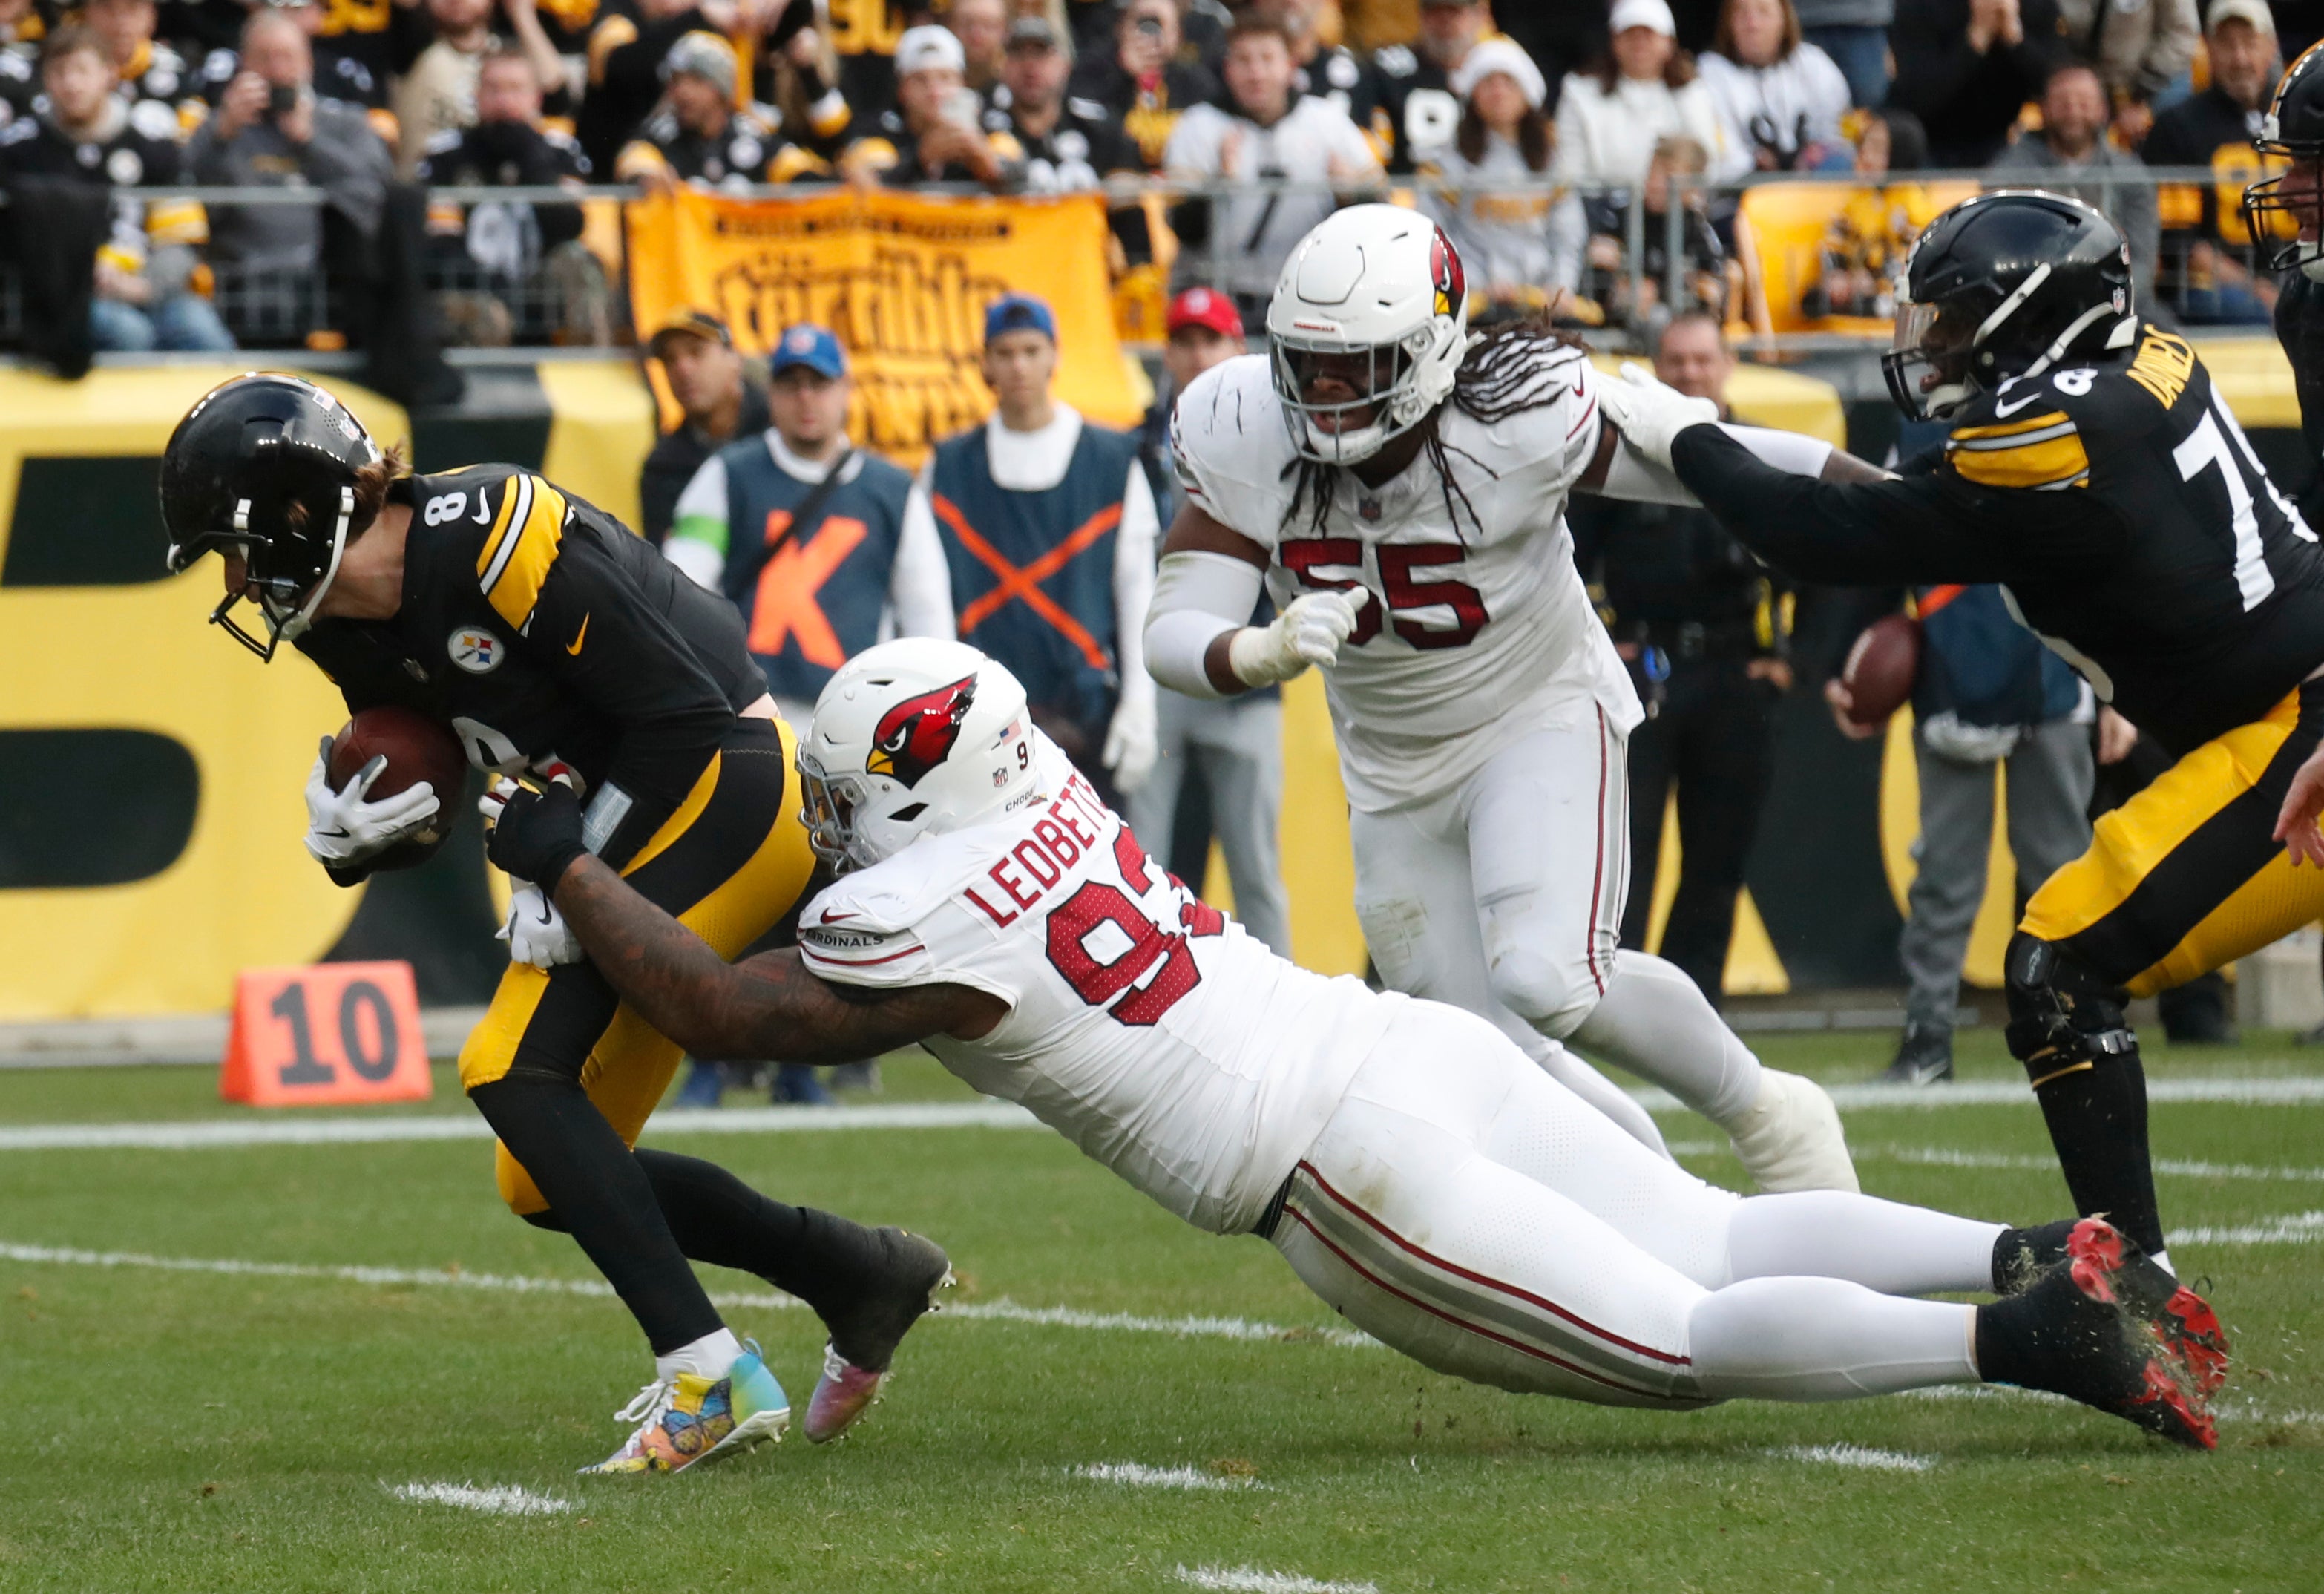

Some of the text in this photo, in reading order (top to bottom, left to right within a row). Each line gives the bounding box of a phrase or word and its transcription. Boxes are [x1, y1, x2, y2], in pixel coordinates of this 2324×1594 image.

[424, 491, 467, 528] 8
[2172, 379, 2320, 614] 7
[748, 509, 867, 669] K
[1280, 537, 1490, 651] 55
[272, 980, 397, 1085] 10
